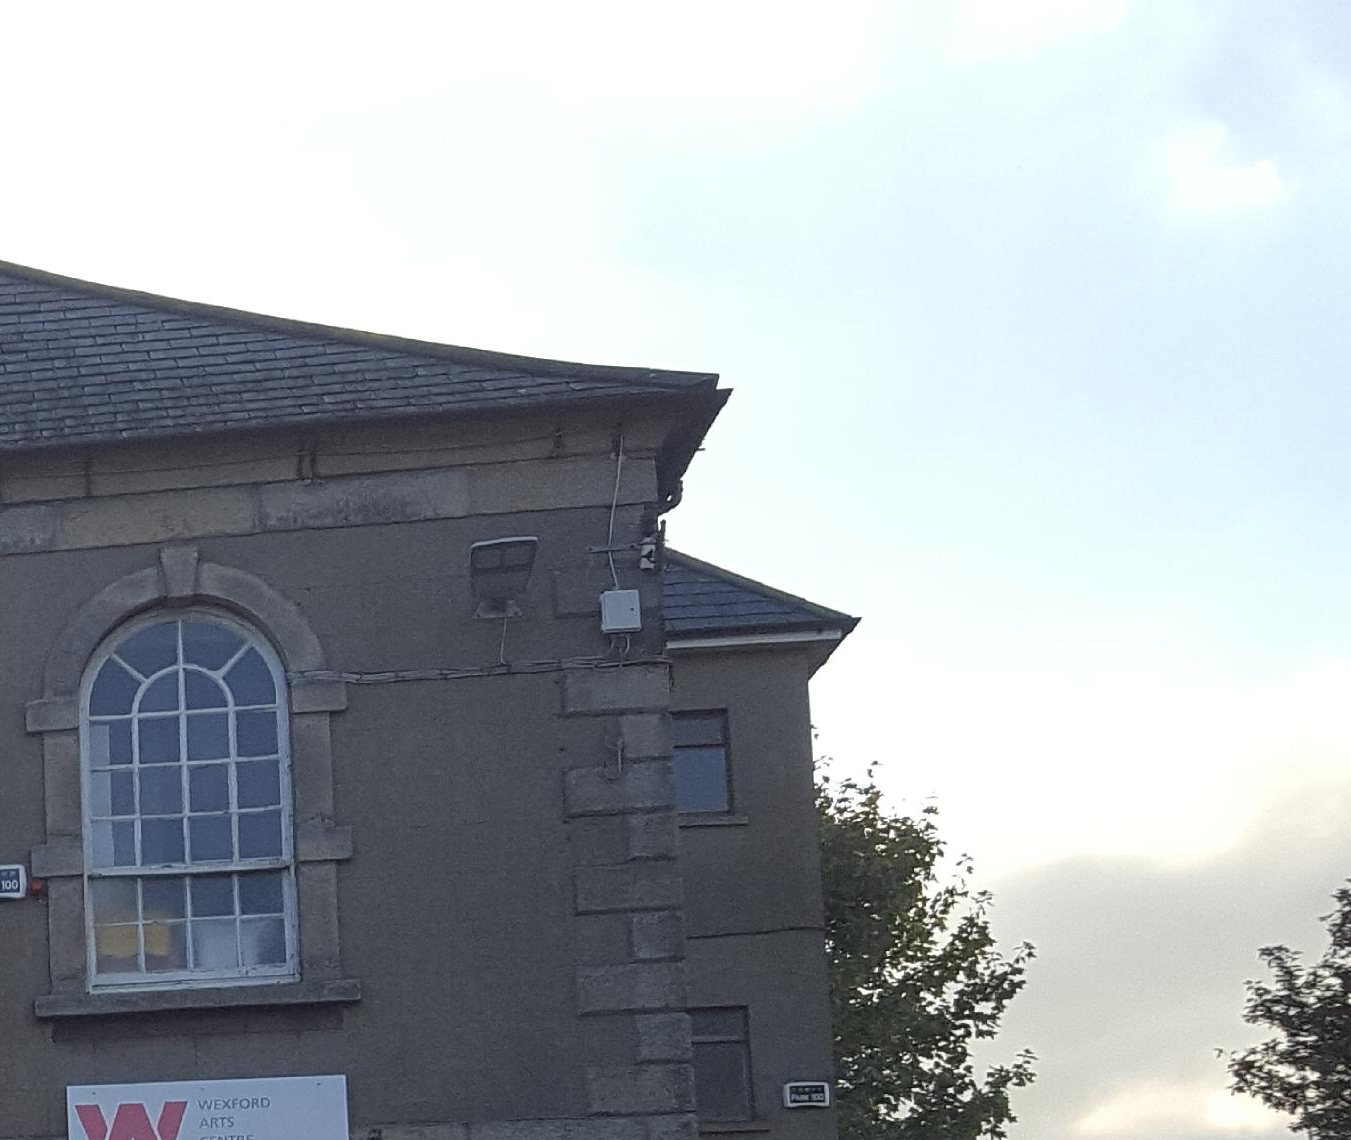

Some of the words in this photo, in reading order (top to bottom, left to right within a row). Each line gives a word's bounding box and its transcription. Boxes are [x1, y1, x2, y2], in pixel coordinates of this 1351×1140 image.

[1, 880, 19, 891] 100
[197, 1096, 271, 1111] WEXFORD
[199, 1116, 235, 1129] ARTS
